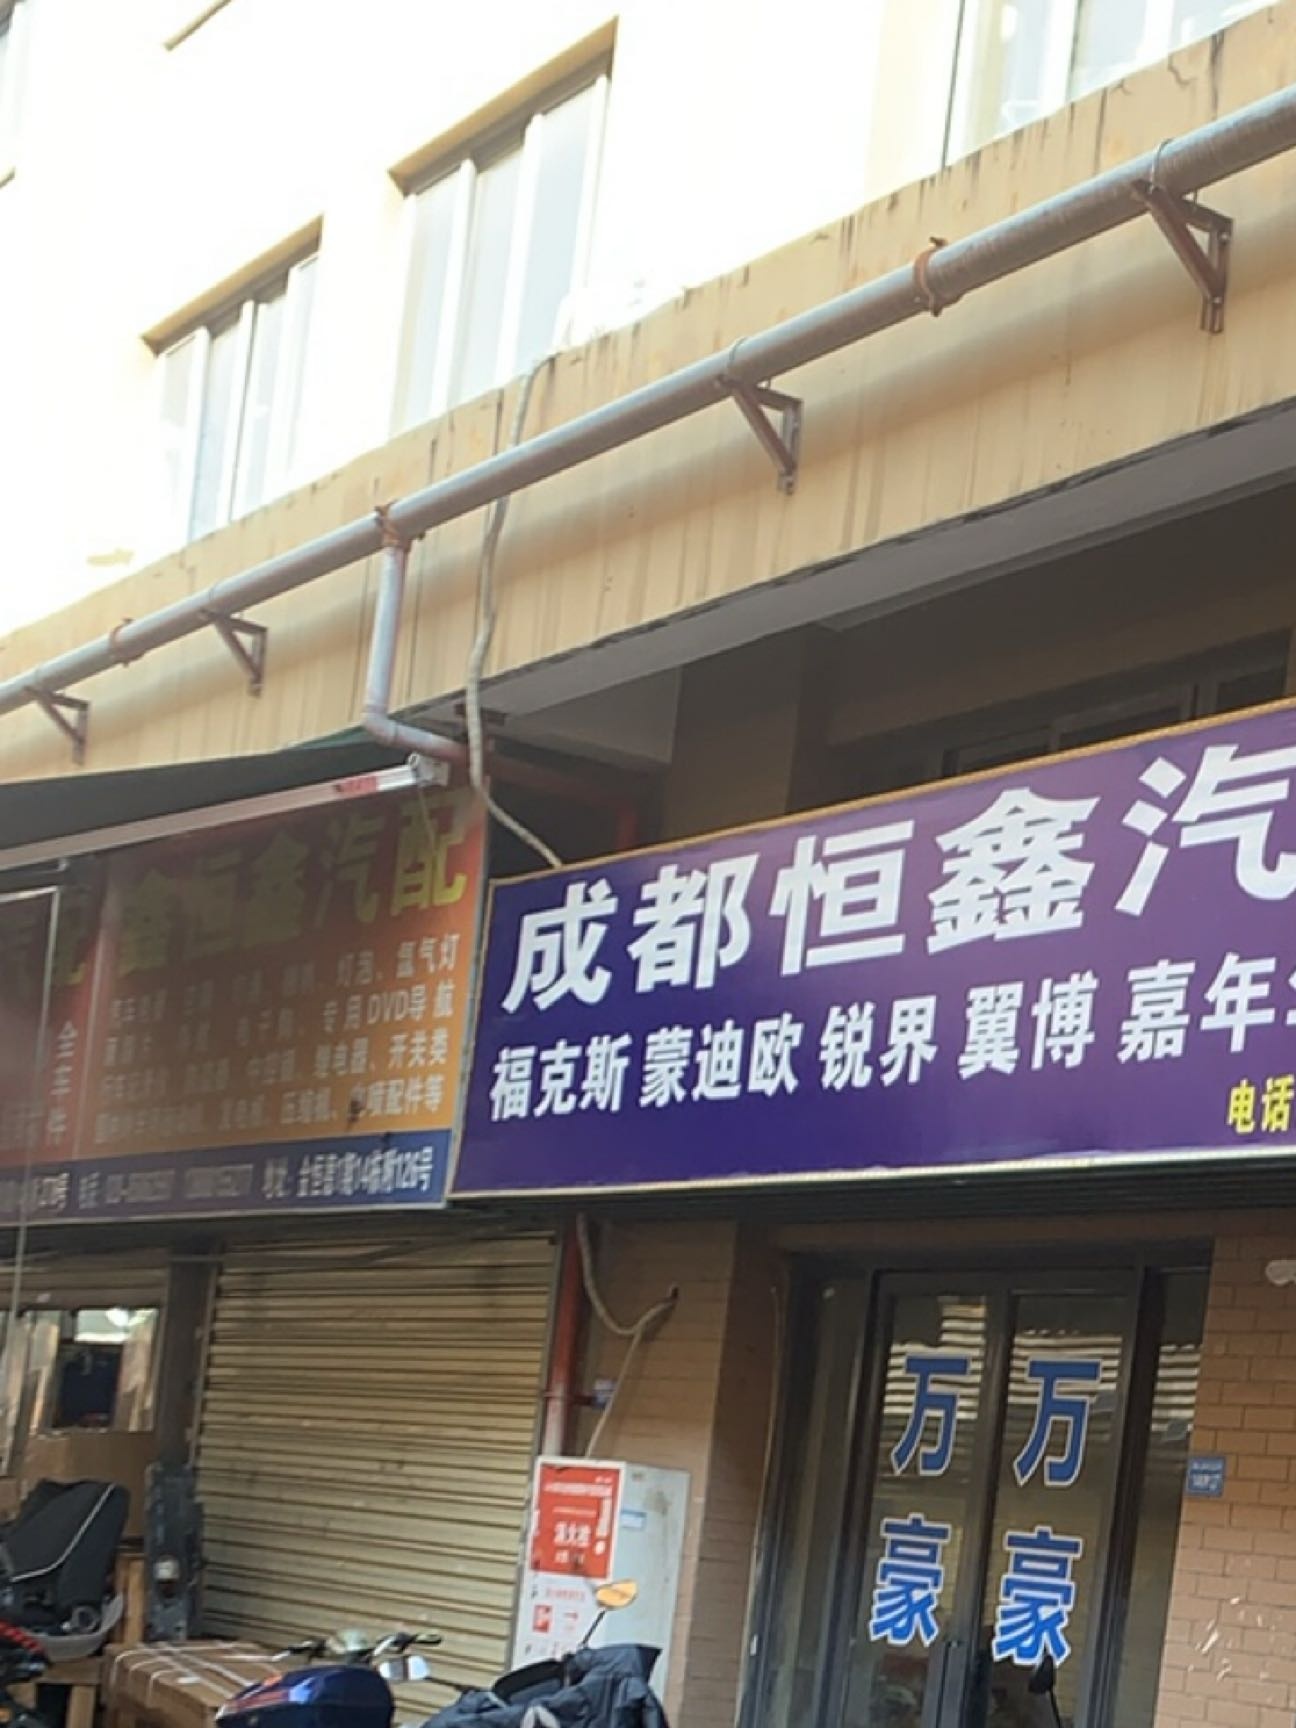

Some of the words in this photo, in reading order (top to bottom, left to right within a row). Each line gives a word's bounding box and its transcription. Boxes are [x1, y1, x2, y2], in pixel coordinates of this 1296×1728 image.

[489, 1031, 633, 1122] 福克斯
[638, 1011, 805, 1108] 蒙迪欧
[818, 993, 939, 1092] 锐界
[956, 968, 1101, 1081] 翼博
[869, 1354, 972, 1648] 万豪
[991, 1358, 1103, 1669] 万豪
